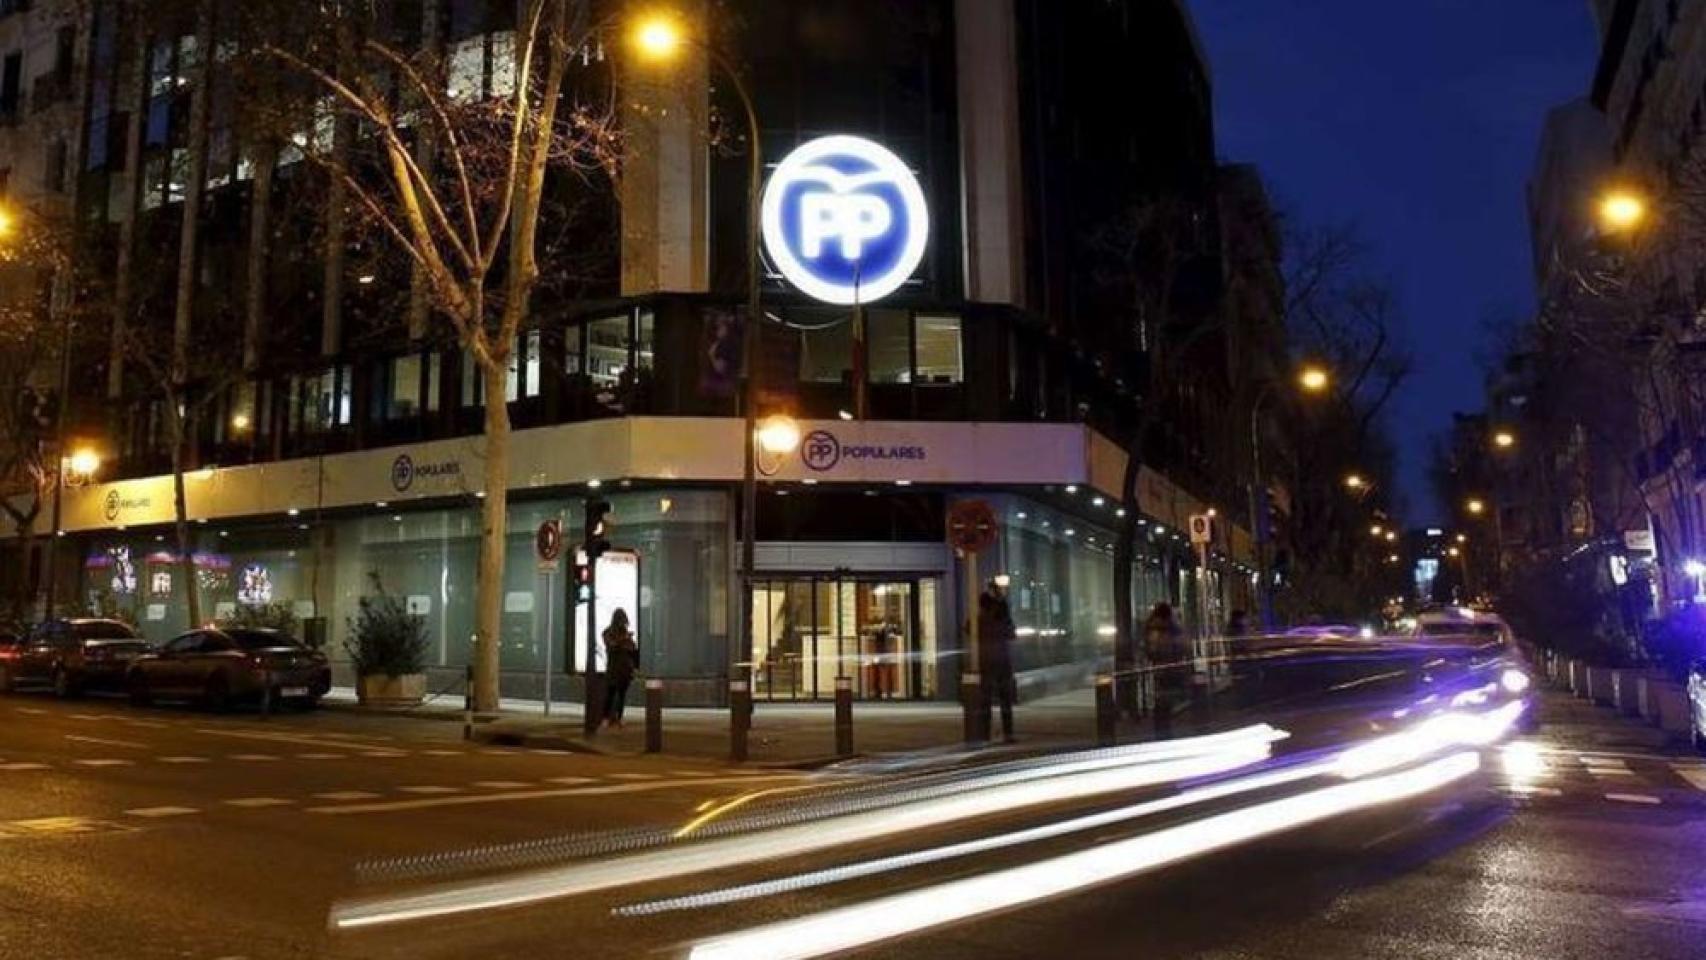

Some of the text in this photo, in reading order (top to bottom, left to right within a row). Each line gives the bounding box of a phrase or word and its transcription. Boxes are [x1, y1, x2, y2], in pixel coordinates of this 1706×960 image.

[800, 191, 892, 259] PP
[808, 444, 926, 460] PP POPULARES
